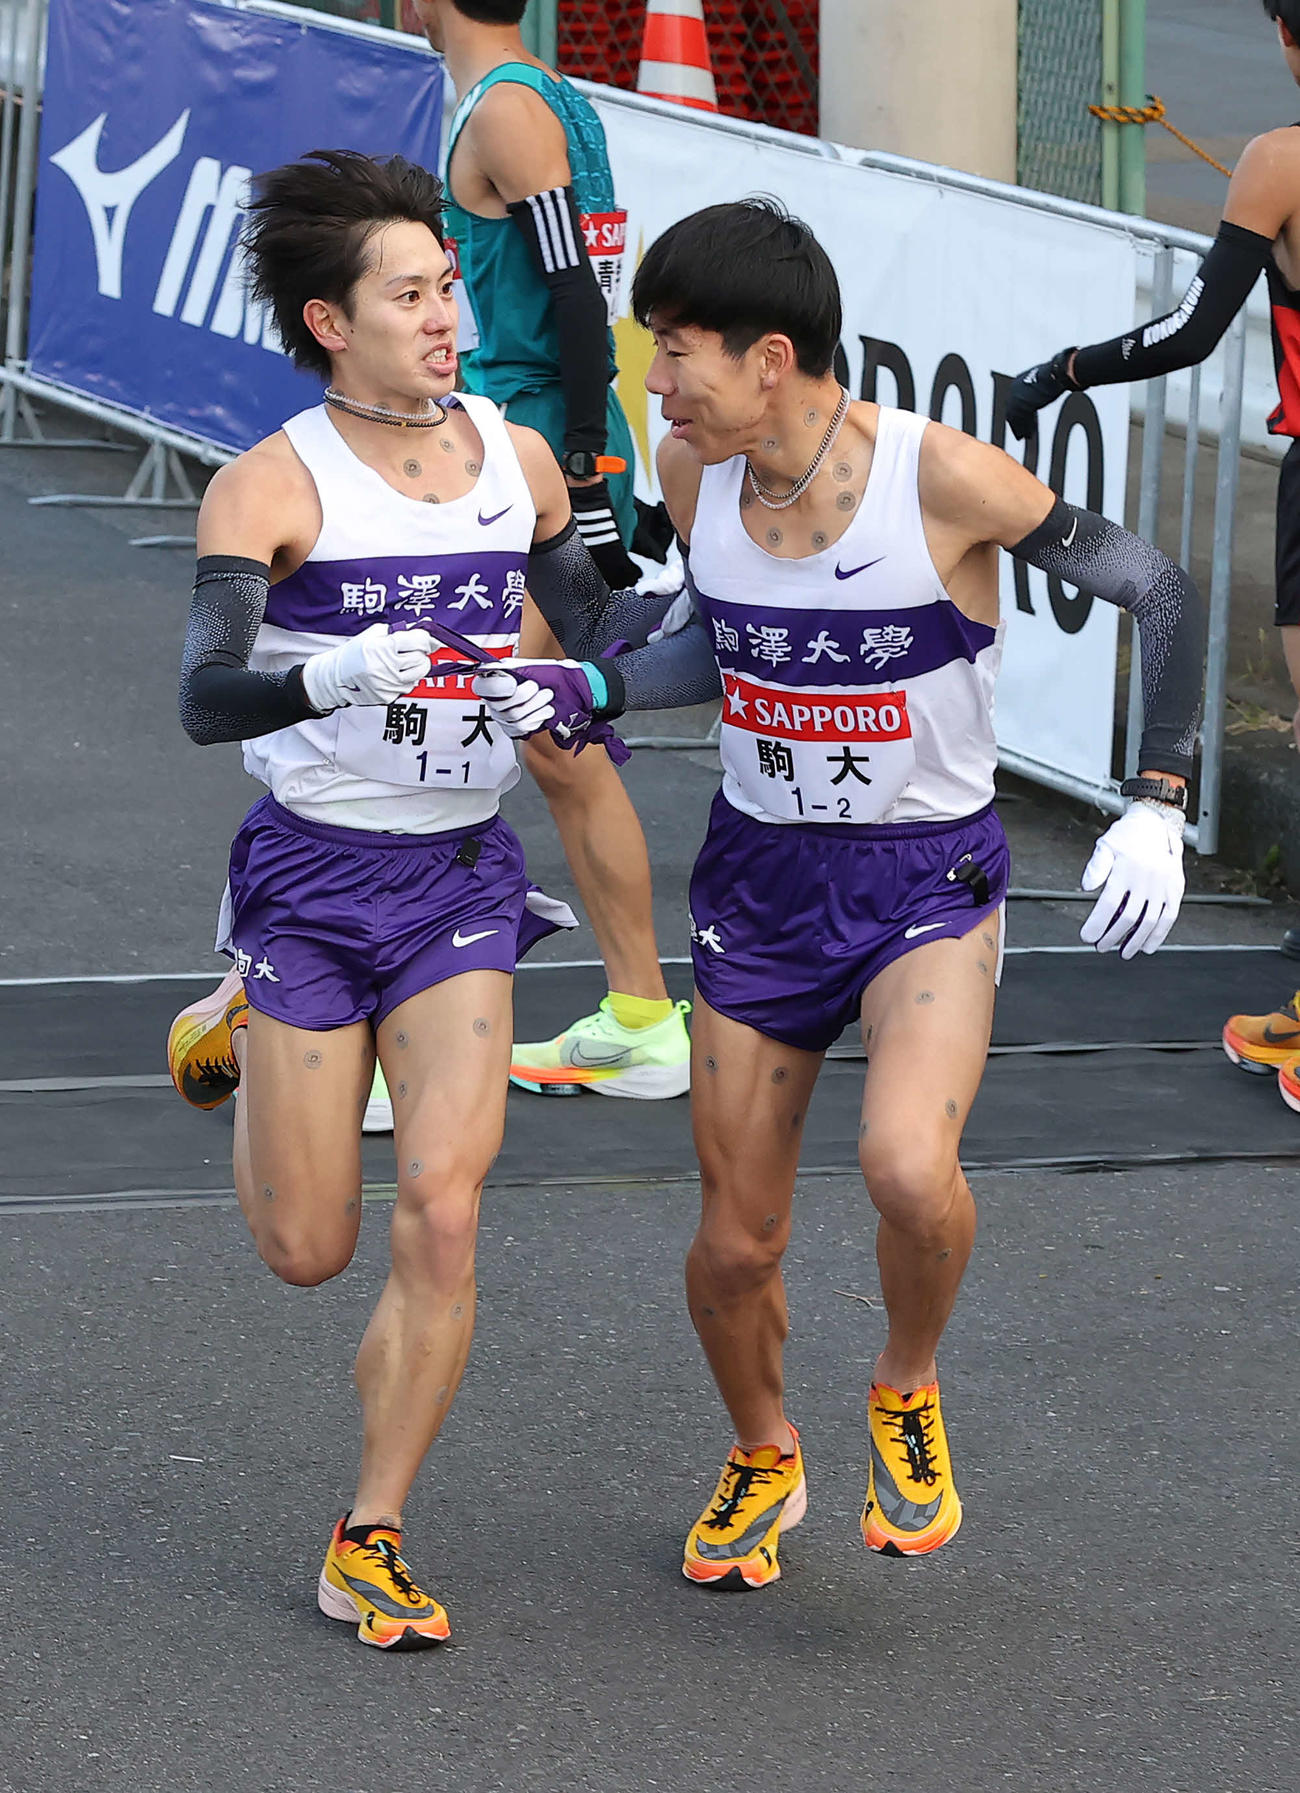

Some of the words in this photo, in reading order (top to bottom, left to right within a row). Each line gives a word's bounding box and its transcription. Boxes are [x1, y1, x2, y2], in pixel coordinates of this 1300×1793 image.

[382, 702, 494, 748] 駒大
[754, 698, 902, 733] SAPPORO
[756, 738, 872, 786] 駒大
